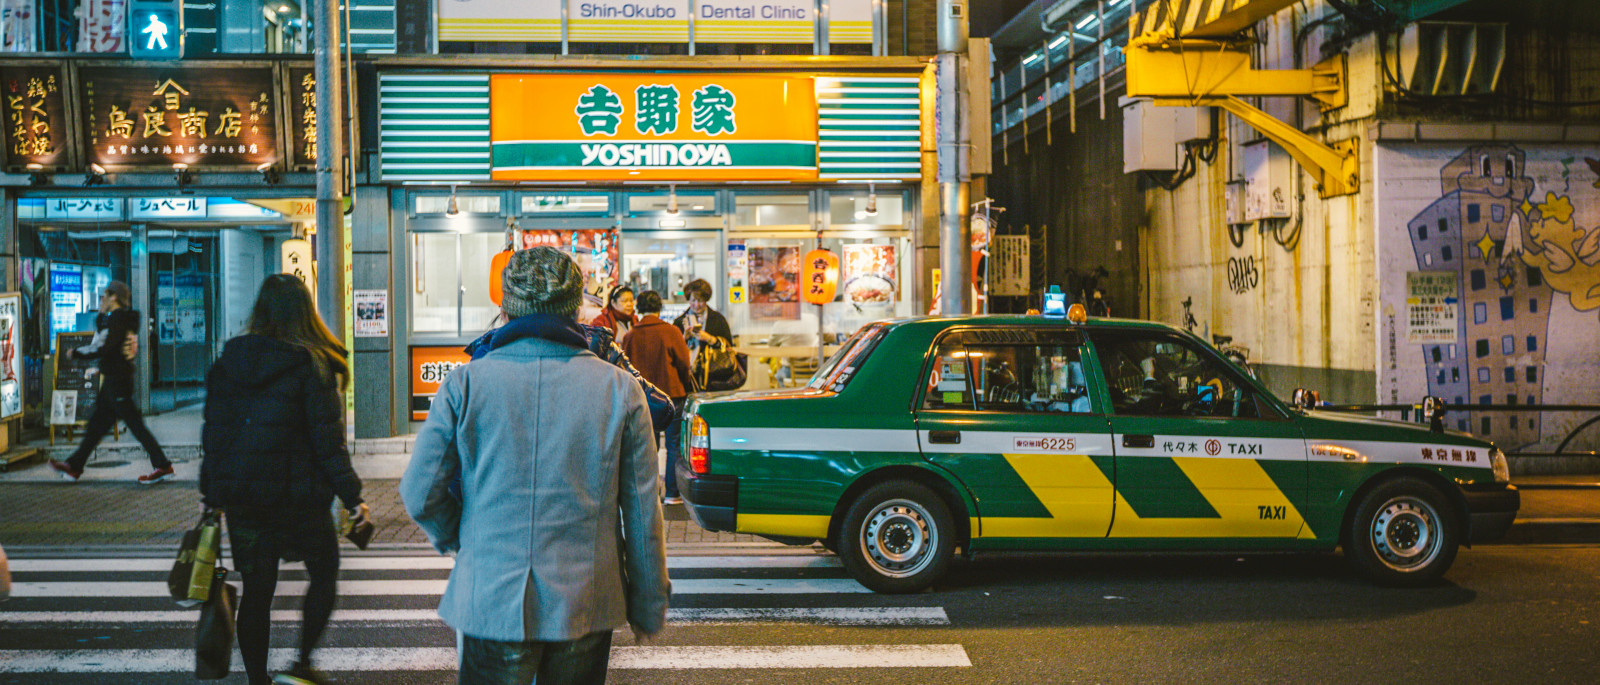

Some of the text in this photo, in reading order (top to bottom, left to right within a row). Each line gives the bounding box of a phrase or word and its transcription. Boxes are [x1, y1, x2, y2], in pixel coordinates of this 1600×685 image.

[580, 3, 806, 19] Shin-Okubo Dental Clinic
[574, 84, 737, 136] 吉野家
[8, 95, 30, 155] とりそば
[105, 104, 242, 138] 鳥良商店
[139, 198, 199, 212] シュベール
[421, 363, 462, 382] お持
[1041, 437, 1075, 450] 6225
[1163, 441, 1263, 455] 代々木 TAXI
[1421, 447, 1477, 462] 東京無線
[1258, 505, 1286, 520] TAXI
